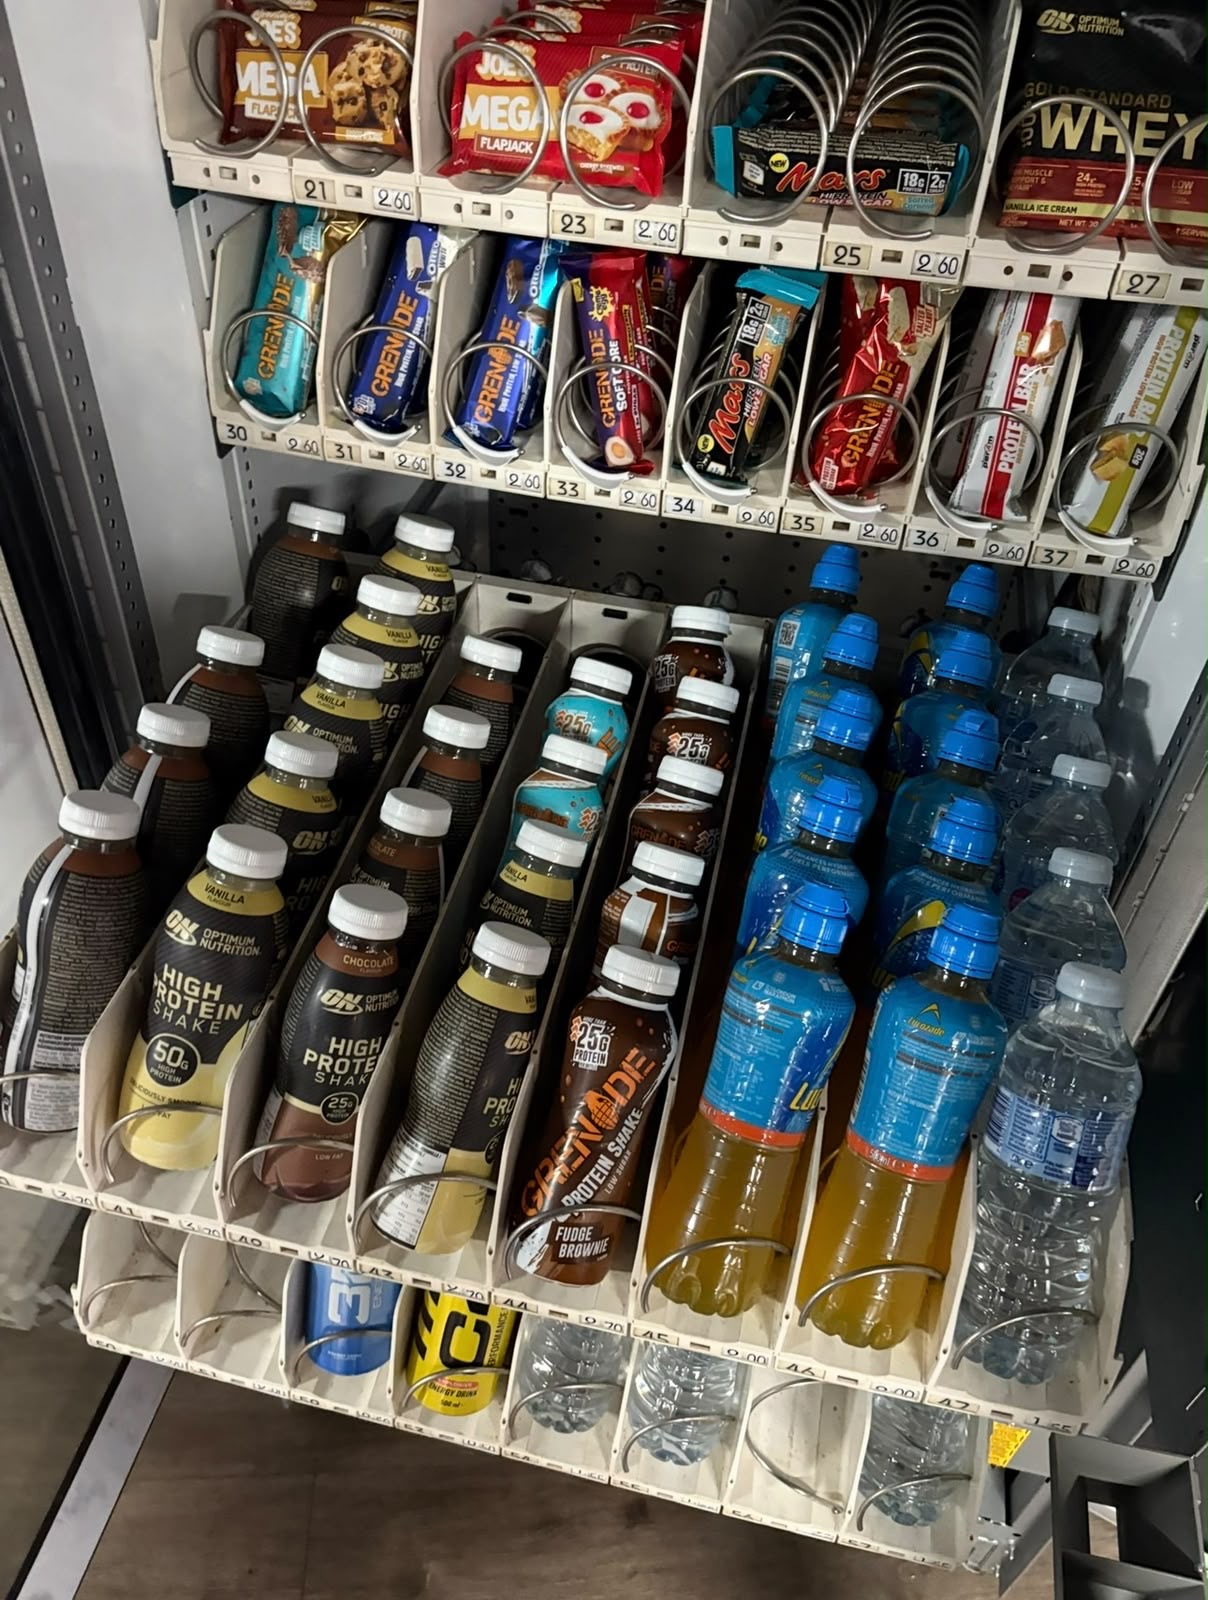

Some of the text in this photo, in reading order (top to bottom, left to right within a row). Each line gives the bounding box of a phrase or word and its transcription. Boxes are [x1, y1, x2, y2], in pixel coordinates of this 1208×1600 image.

[1077, 24, 1124, 36] NUTRITION
[1079, 15, 1120, 26] OPTIMUM
[461, 95, 556, 131] MEGA
[1040, 103, 1208, 160] WHEY
[480, 137, 533, 154] FLAPJACK
[776, 161, 885, 192] Mars
[304, 180, 328, 201] 21
[1005, 203, 1077, 214] VANILLA ICE CREAM
[561, 214, 587, 234] 23
[834, 245, 861, 266] 25
[529, 265, 542, 298] OREO
[1129, 274, 1160, 296] 27
[1148, 326, 1185, 400] PROTEIN
[613, 378, 628, 412] SOFT
[998, 364, 1035, 473] PROTEN BAR
[226, 425, 248, 441] 30
[336, 444, 354, 460] 31
[444, 463, 466, 479] 32
[556, 482, 579, 497] 33
[672, 499, 695, 514] 34
[790, 515, 815, 531] 35
[912, 530, 939, 547] 36
[1041, 550, 1069, 565] 37
[316, 692, 346, 709] VANILLA
[562, 714, 591, 735] 25G
[313, 727, 354, 744] OPTIMUM
[679, 737, 709, 758] 25G
[293, 831, 328, 850] ON
[205, 884, 245, 905] VANILLA
[490, 903, 531, 926] NUTRITION
[493, 896, 529, 917] OPTIMUM
[166, 909, 256, 945] ON OPTIMUM
[200, 938, 260, 956] NUTRITION
[343, 955, 394, 969] CHOCOLATE
[163, 963, 223, 1001] HIGH
[153, 972, 243, 1020] PROTEIN
[320, 988, 364, 1015] ON
[153, 1000, 222, 1035] SHAKE
[328, 1036, 382, 1057] HIGH
[577, 1023, 609, 1051] 25G
[153, 1039, 189, 1070] 50G
[303, 1048, 379, 1075] PROTE
[575, 1049, 606, 1064] PROTEIN
[149, 1068, 181, 1084] PROTEIN
[158, 1063, 177, 1075] HIGH
[314, 1072, 368, 1086] SHAK
[328, 1097, 353, 1108] 25G
[521, 1047, 655, 1218] GRENADE
[552, 1108, 643, 1222] PROTEIN SHAKE
[604, 1149, 632, 1194] LOW SUGAR
[556, 1226, 594, 1241] FUDGE
[559, 1236, 611, 1258] BROWNIE
[487, 1309, 508, 1367] ERFORMANCE
[429, 1381, 478, 1398] ENERGY DRINK
